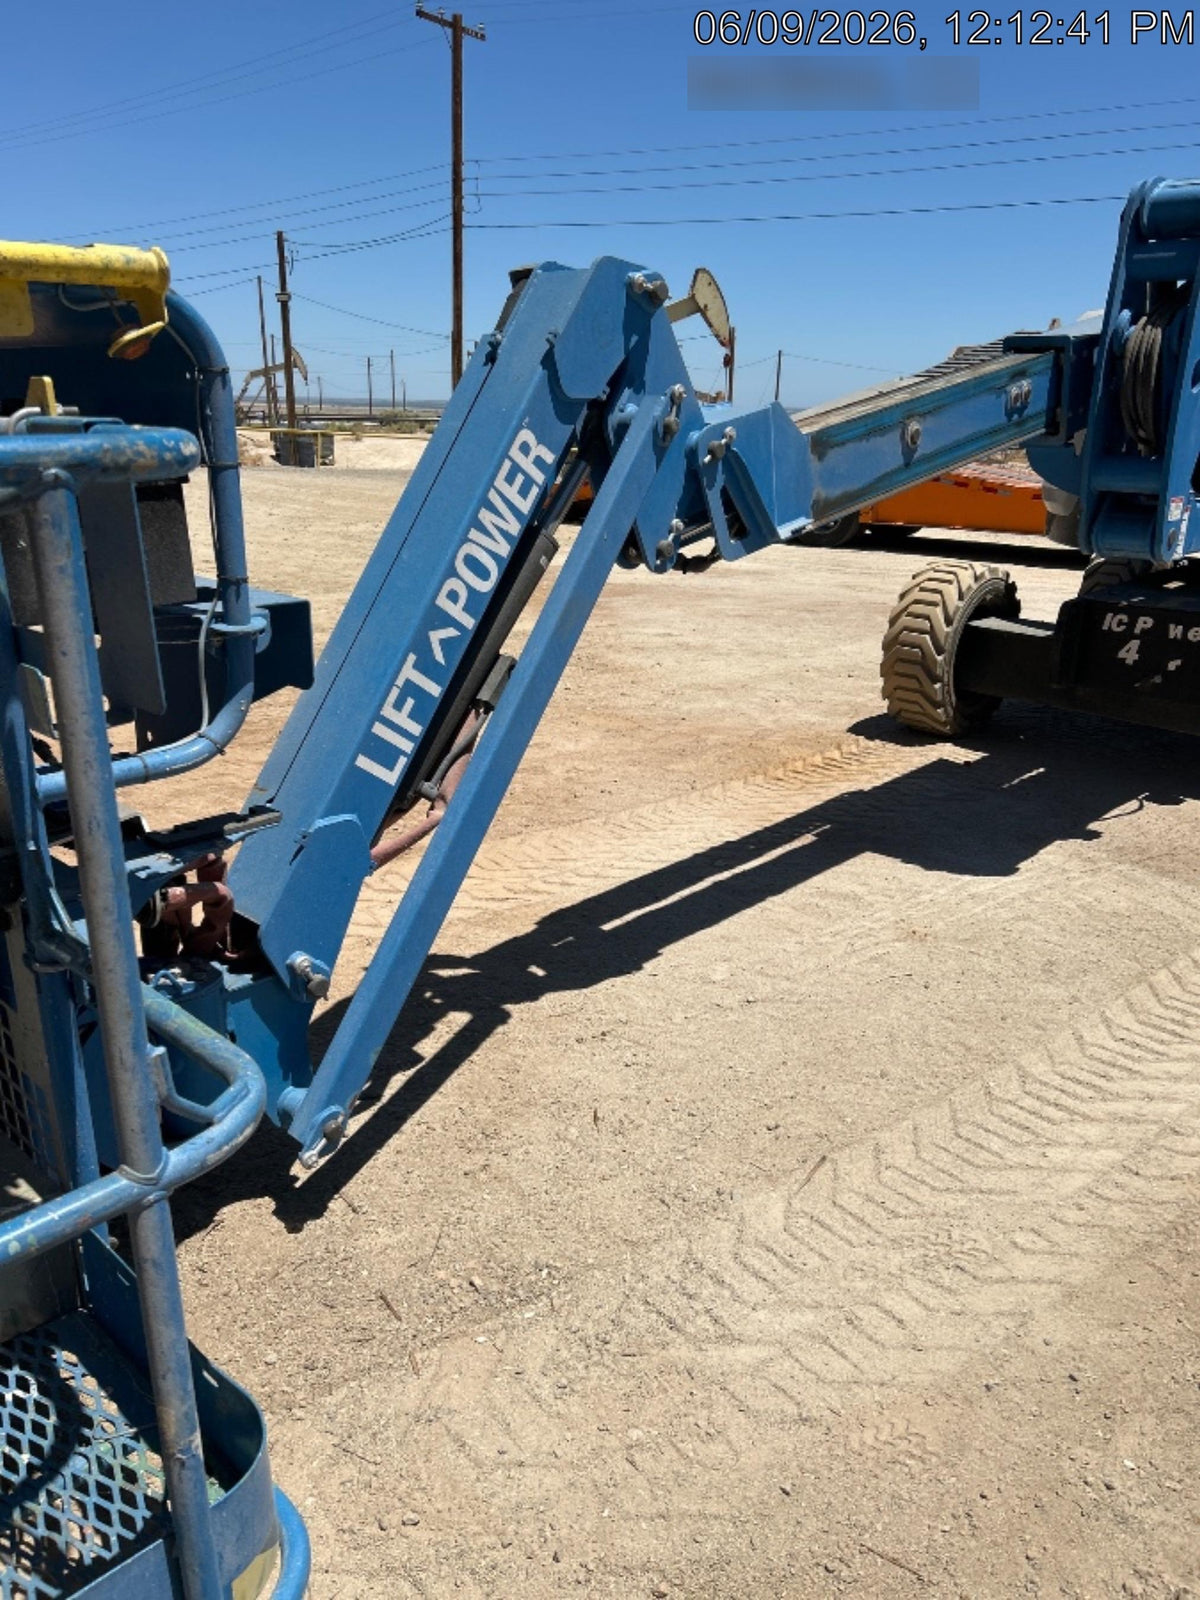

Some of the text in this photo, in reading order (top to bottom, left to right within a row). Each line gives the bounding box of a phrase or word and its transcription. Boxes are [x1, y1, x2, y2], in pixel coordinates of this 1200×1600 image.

[355, 428, 556, 786] LIFT POWER
[1117, 639, 1140, 665] 4
